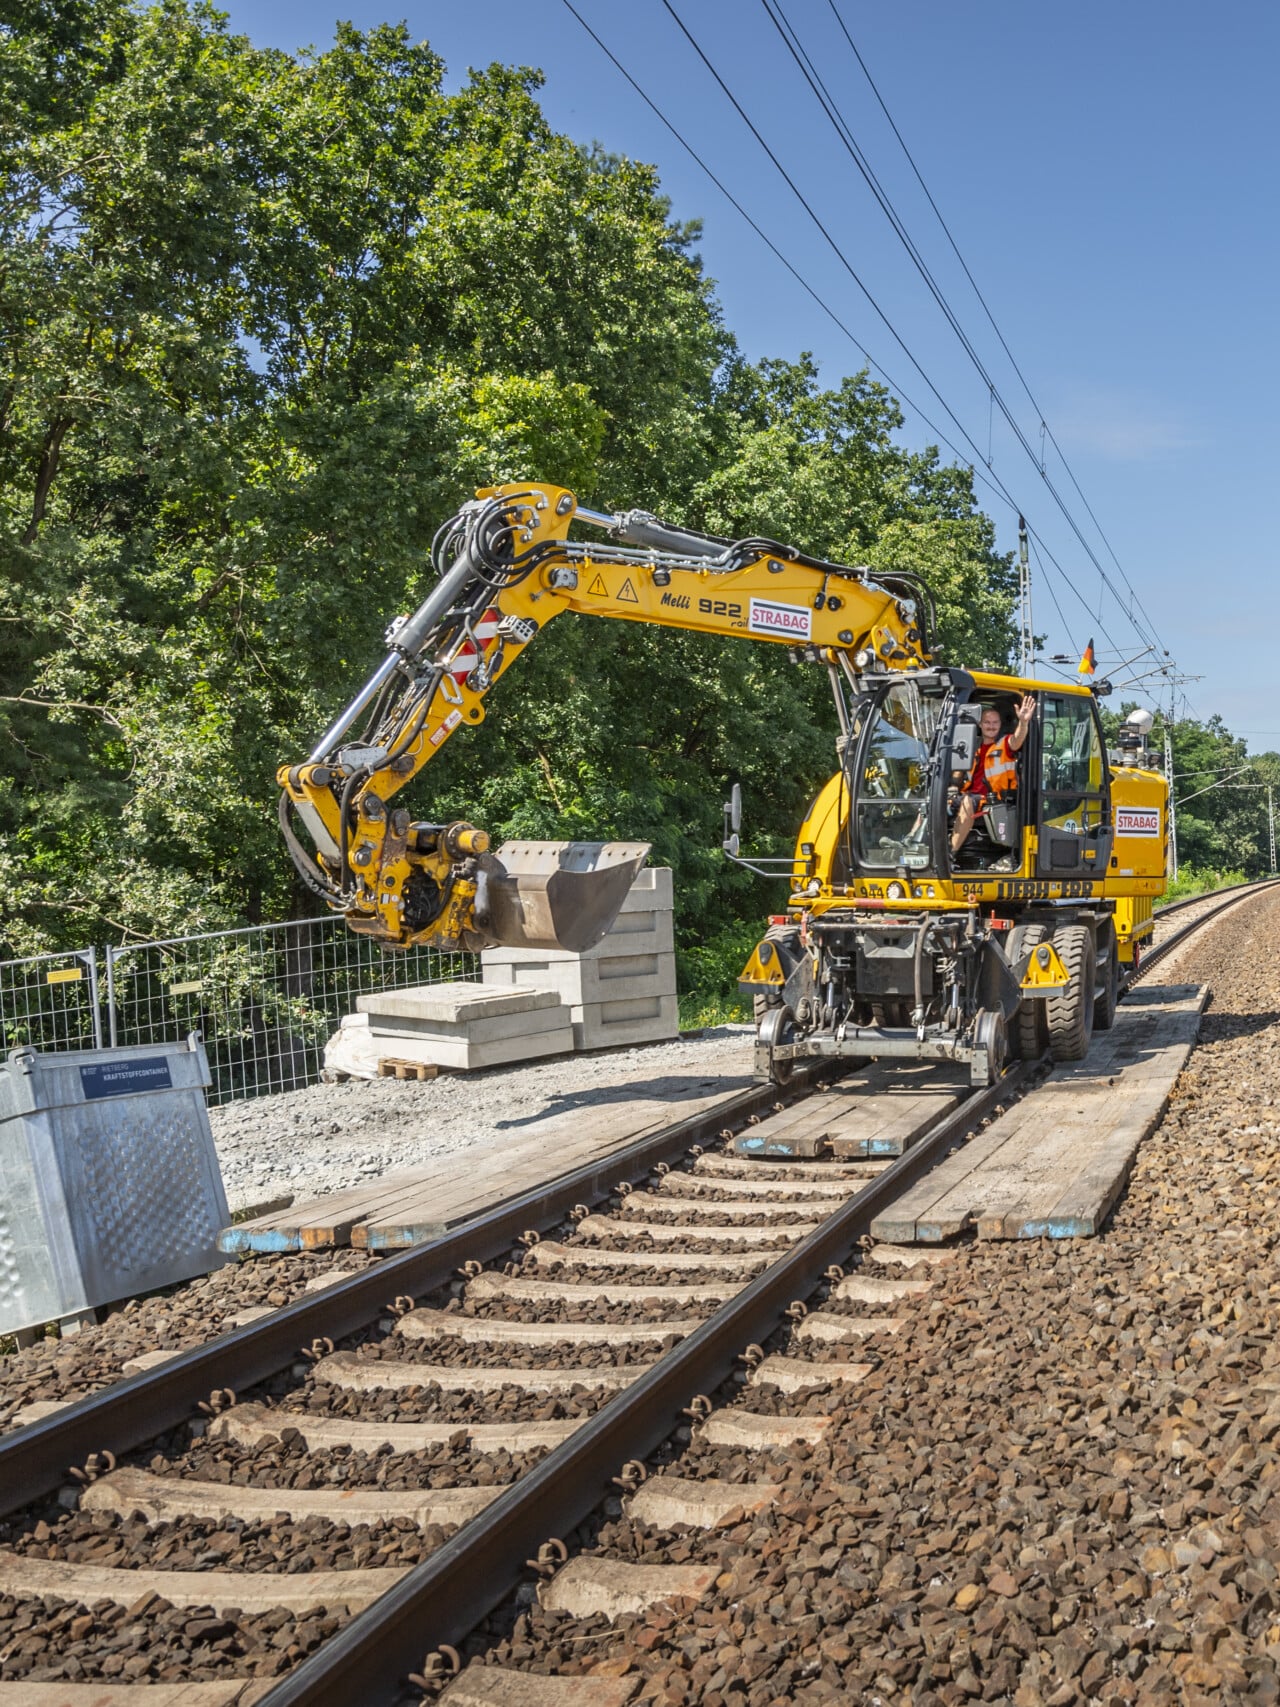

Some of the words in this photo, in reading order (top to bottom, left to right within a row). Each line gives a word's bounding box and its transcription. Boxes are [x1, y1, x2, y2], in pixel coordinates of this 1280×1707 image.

[661, 592, 691, 610] Melli
[699, 598, 742, 618] 922
[752, 608, 808, 630] STRABAG
[1118, 816, 1157, 828] STRABAG
[962, 884, 984, 897] 944
[103, 1067, 168, 1081] KRAFTSTOFFCONTAINER
